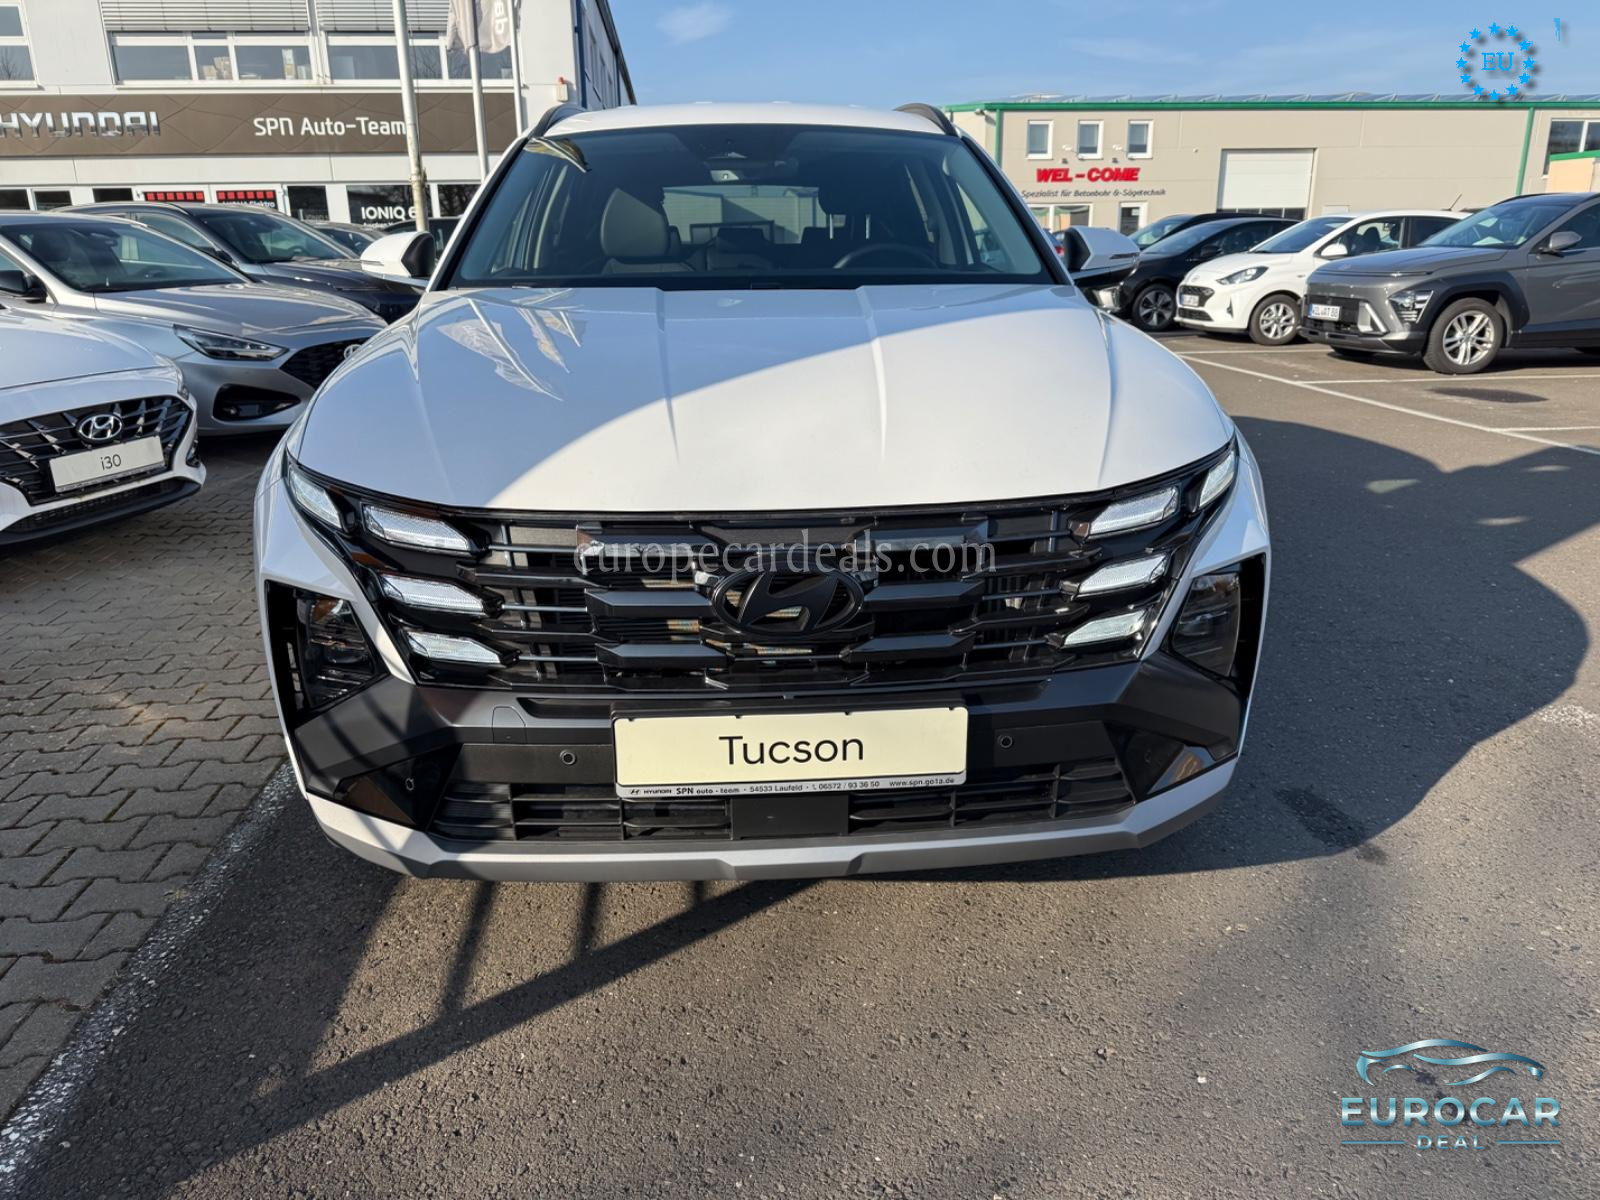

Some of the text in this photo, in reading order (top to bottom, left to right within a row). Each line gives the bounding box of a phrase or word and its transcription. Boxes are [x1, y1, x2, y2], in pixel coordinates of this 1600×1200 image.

[0, 111, 161, 138] HYUNDAI
[253, 117, 407, 137] SPN Auto-Team
[361, 206, 406, 221] IONIQ
[100, 454, 122, 470] i30
[718, 735, 864, 765] Tucson
[676, 787, 694, 795] SPN
[775, 784, 803, 792] Laufeld
